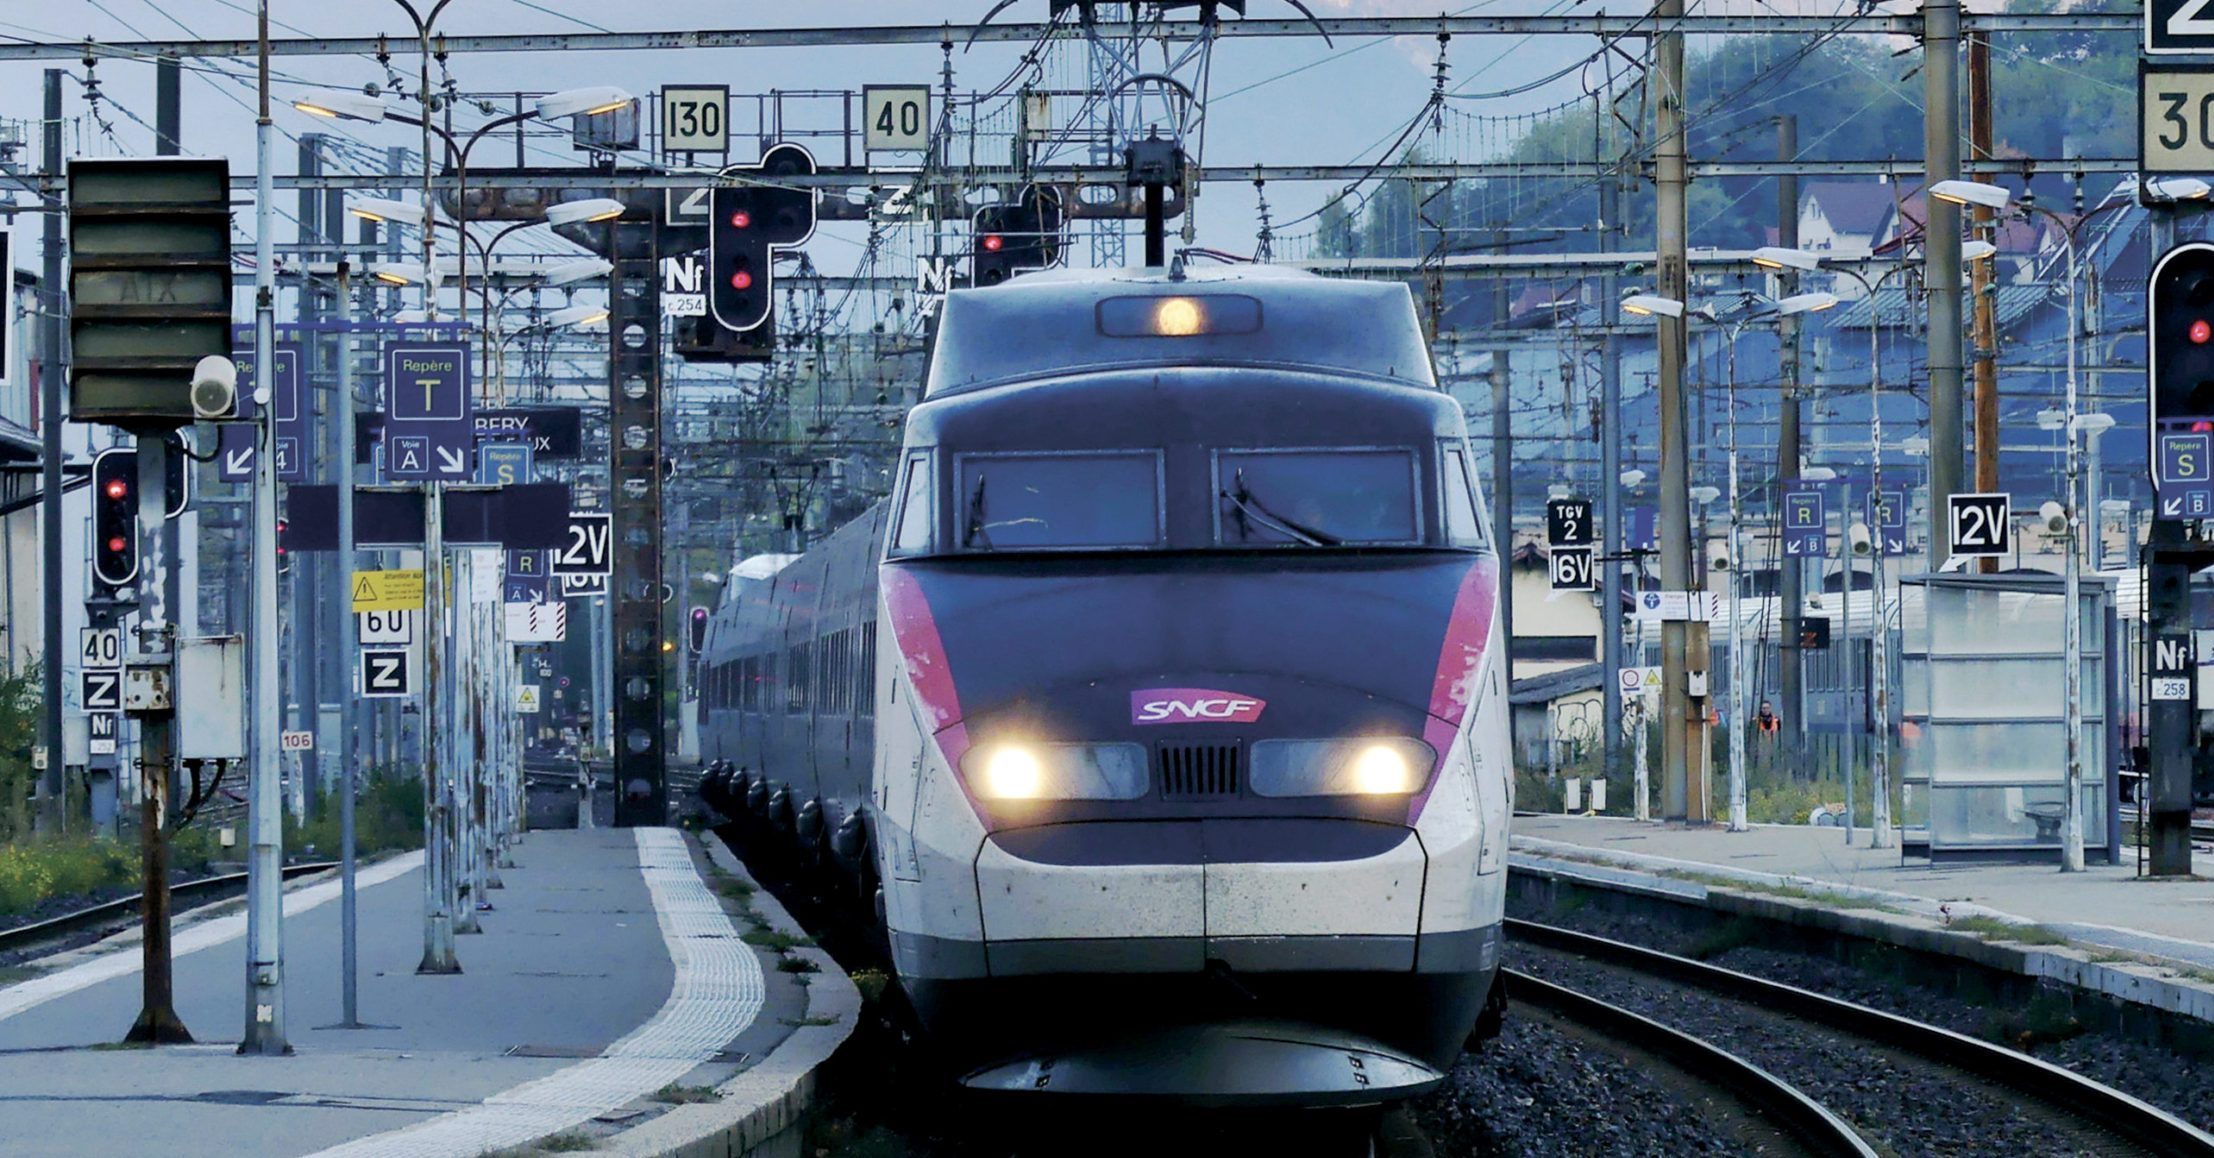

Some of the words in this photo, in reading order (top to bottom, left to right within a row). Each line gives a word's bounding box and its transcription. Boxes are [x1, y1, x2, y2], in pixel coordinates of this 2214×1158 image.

[670, 101, 720, 137] 130
[876, 101, 919, 136] 40
[666, 257, 704, 292] Nf
[403, 360, 452, 374] Repère
[415, 379, 441, 412] T
[401, 440, 420, 449] Voie
[401, 450, 419, 470] A
[2178, 454, 2195, 476] S
[498, 464, 514, 485] S
[1556, 505, 1584, 519] TGV
[1799, 507, 1811, 524] R
[2194, 500, 2204, 512] B
[1564, 520, 1577, 540] 2
[1953, 505, 2005, 545] 12V
[1810, 541, 1818, 551] B
[520, 556, 532, 572] R
[1552, 554, 1591, 583] 16V
[85, 634, 117, 660] 40
[2156, 640, 2187, 670] Nf
[372, 658, 399, 687] Z
[87, 676, 116, 706] Z
[1138, 699, 1257, 720] SNCF
[284, 734, 310, 748] 106
